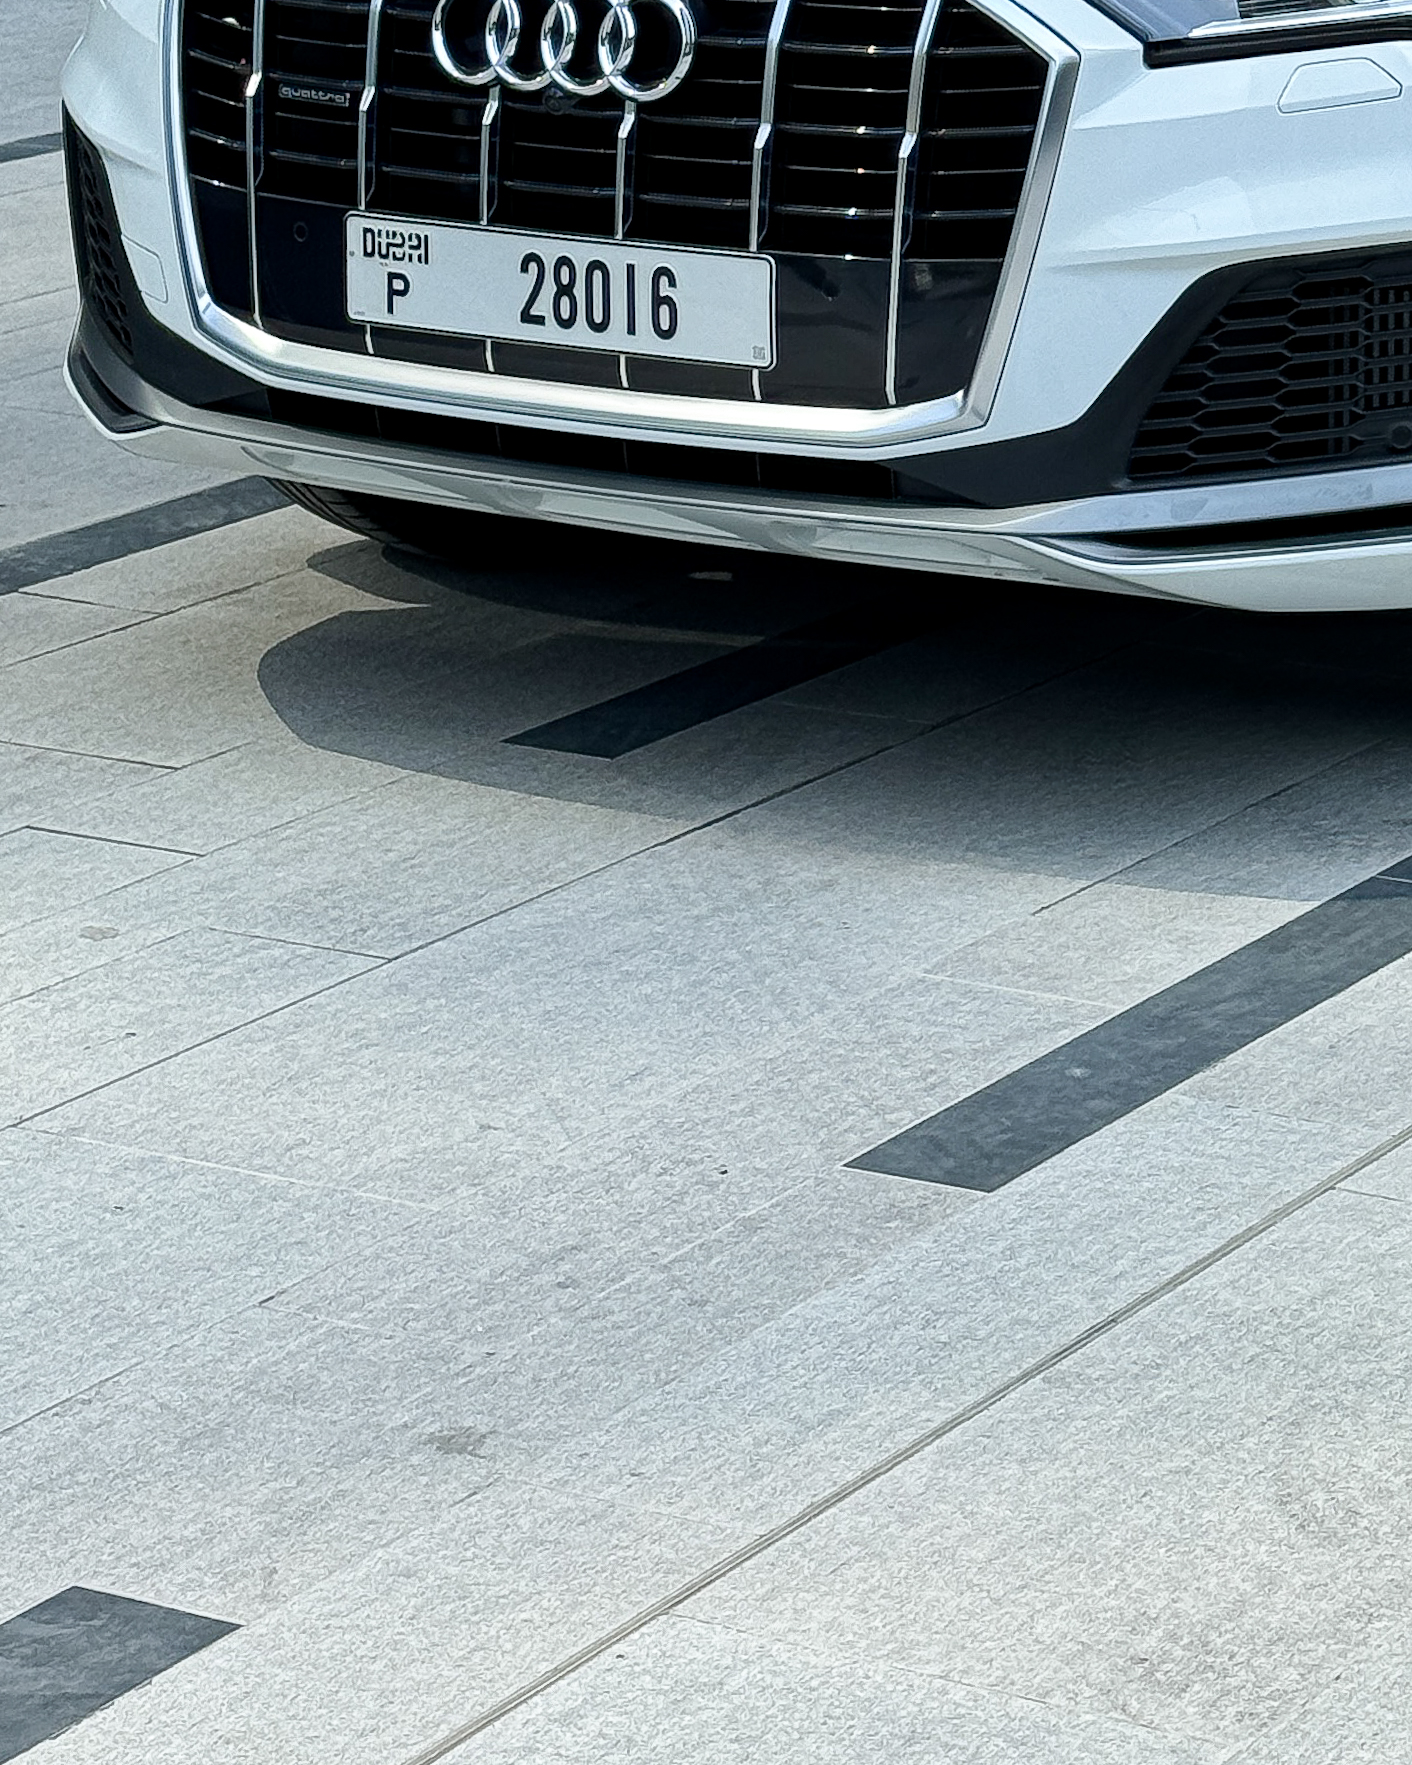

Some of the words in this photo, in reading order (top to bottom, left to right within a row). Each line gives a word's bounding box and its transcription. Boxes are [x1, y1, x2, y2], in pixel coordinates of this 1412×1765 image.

[280, 86, 345, 104] quattro
[362, 226, 429, 266] DUBAI
[386, 271, 411, 315] P
[519, 251, 679, 340] 28016
